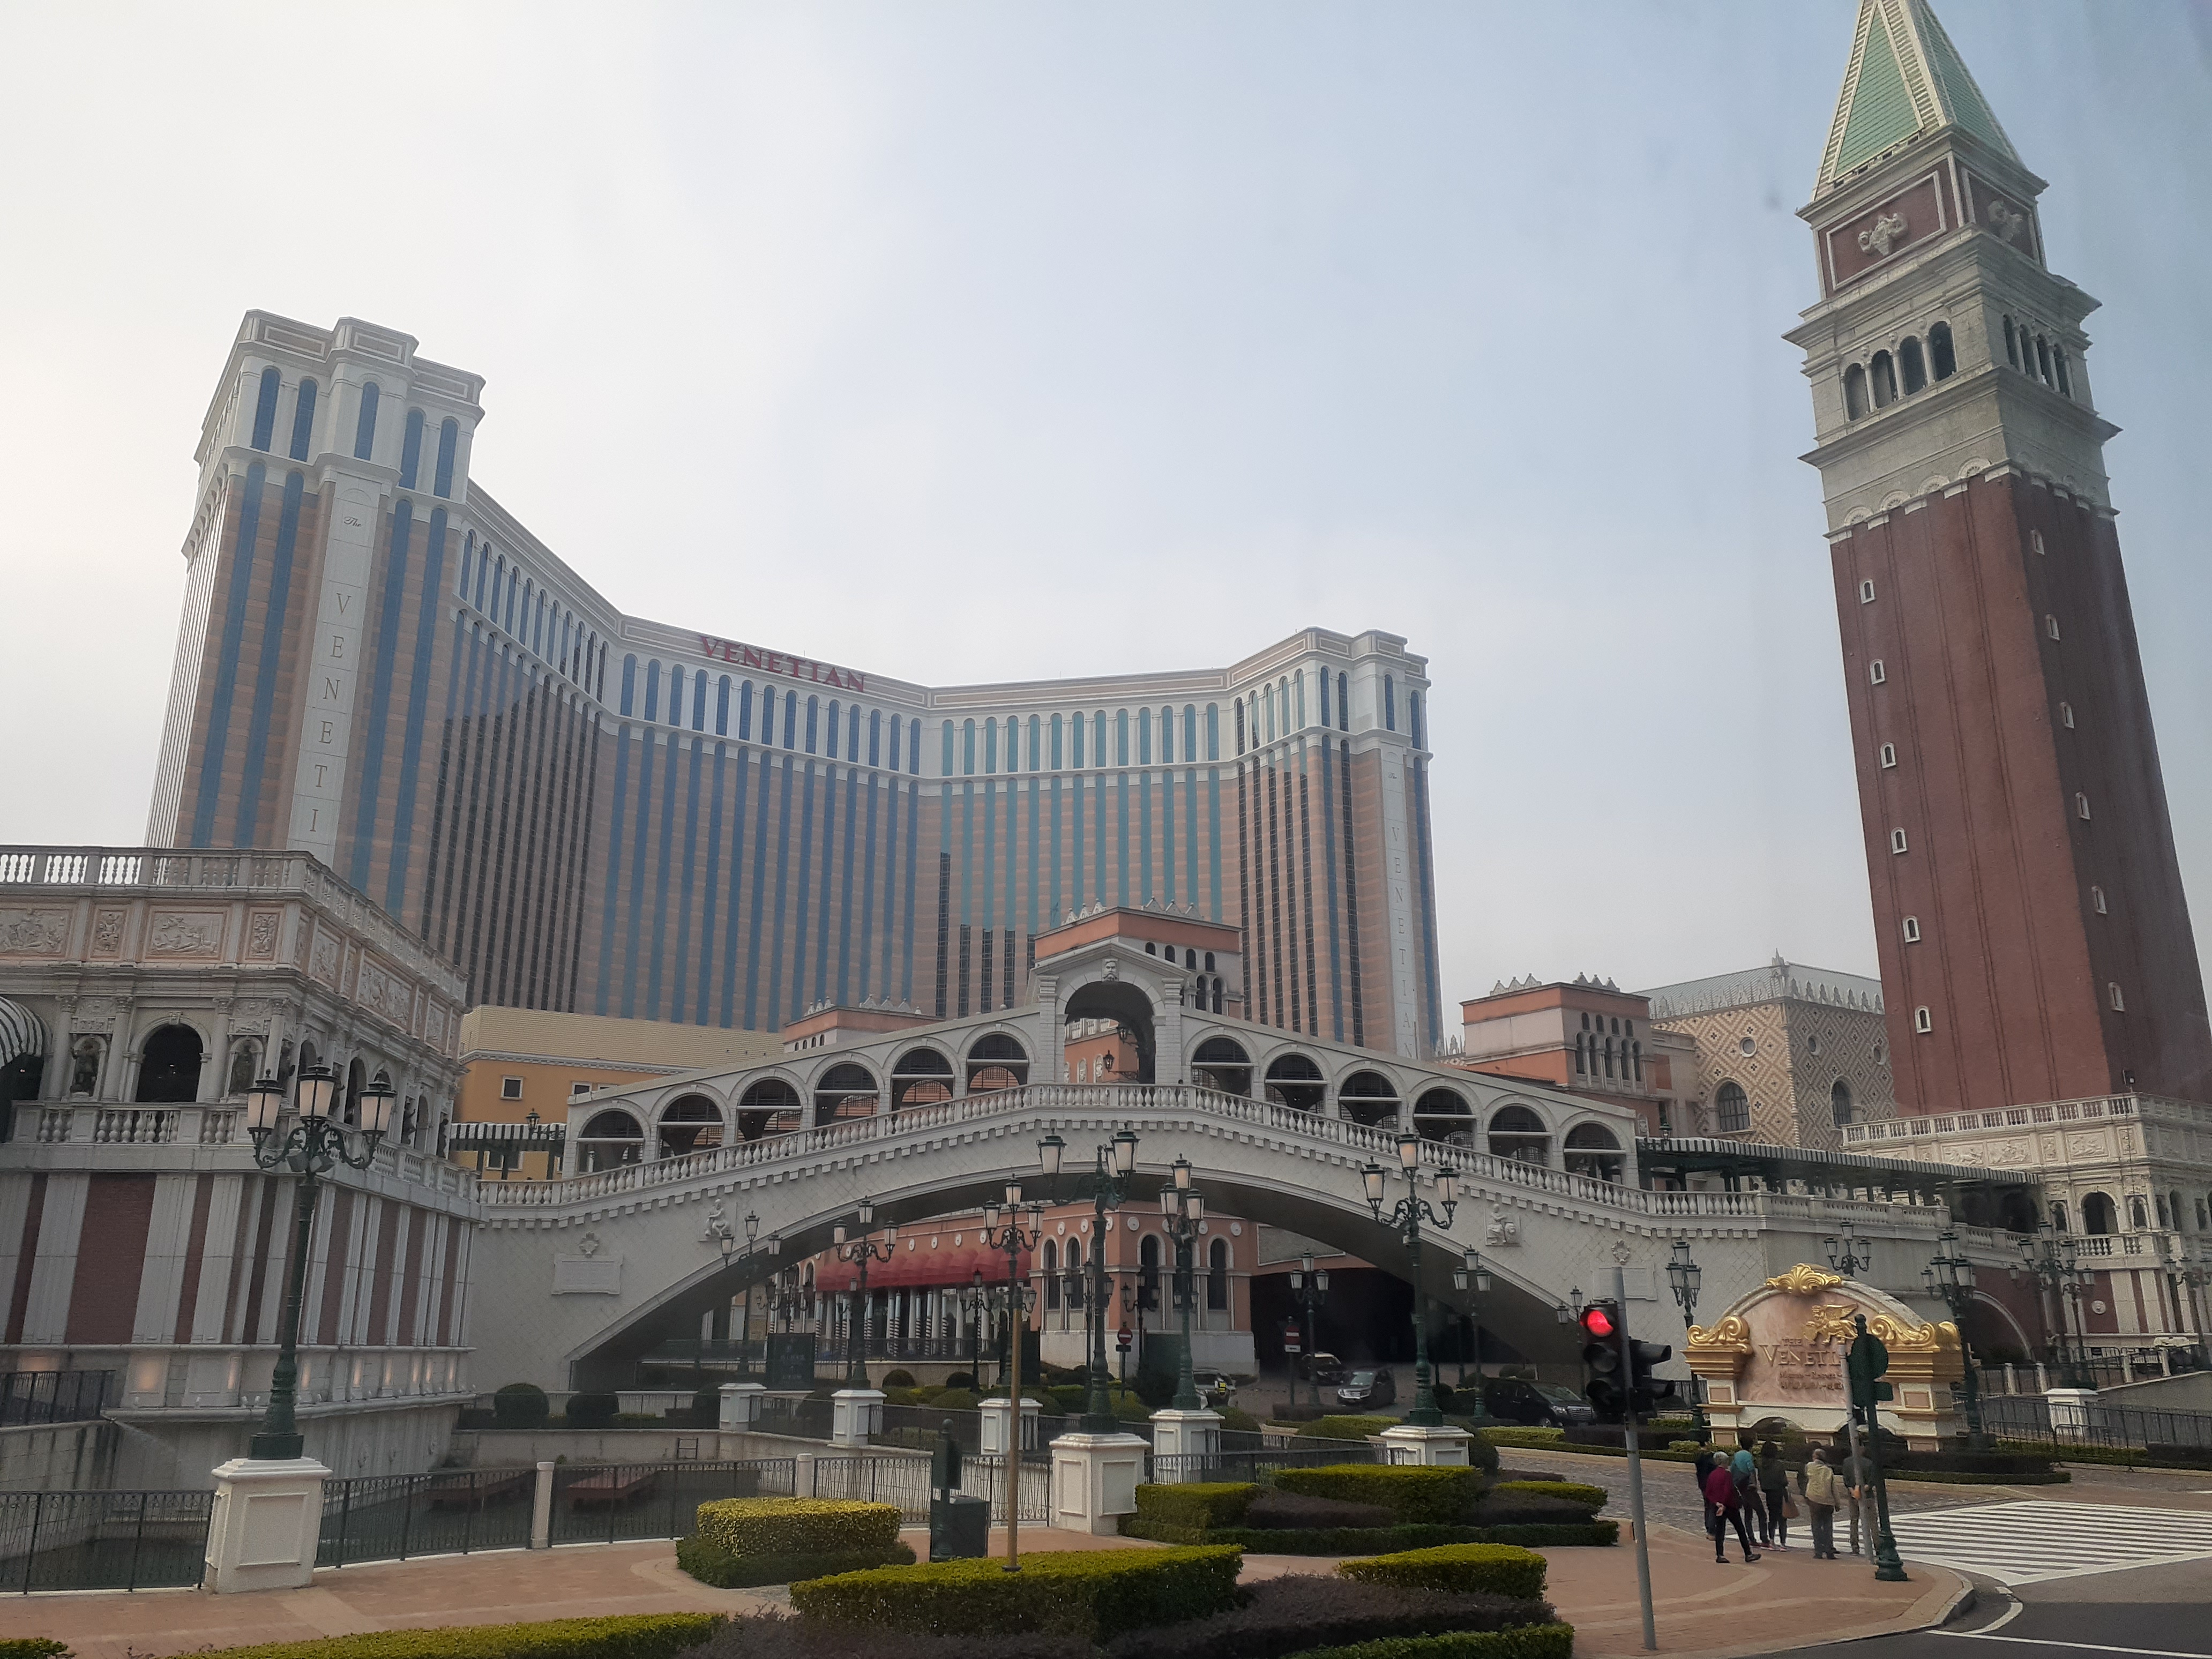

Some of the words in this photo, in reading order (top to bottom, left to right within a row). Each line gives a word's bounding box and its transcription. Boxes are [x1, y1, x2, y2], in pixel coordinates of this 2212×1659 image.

[343, 516, 362, 527] The
[698, 635, 866, 693] VENETIAN
[1392, 826, 1413, 1058] VENETIAN
[1782, 1337, 1803, 1347] THE
[1758, 1344, 1842, 1367] VENETI
